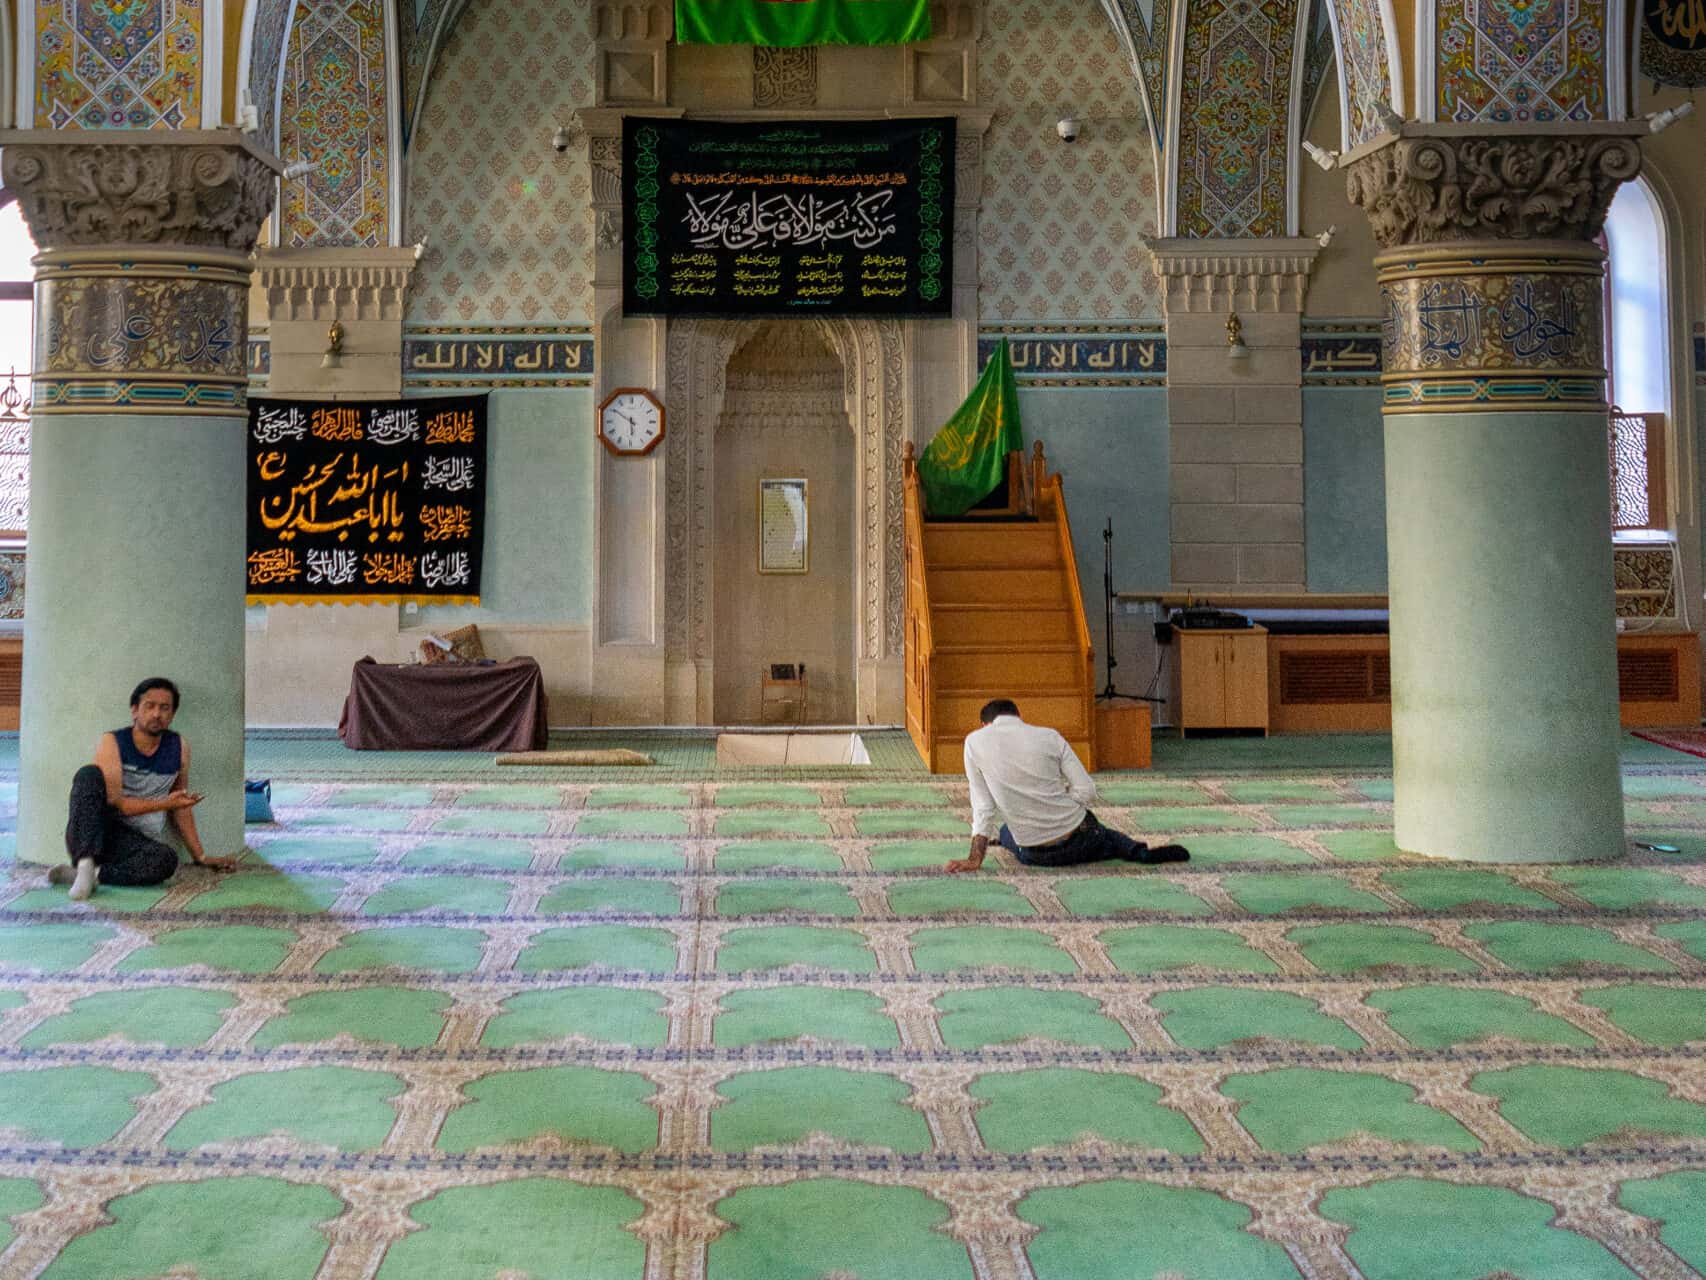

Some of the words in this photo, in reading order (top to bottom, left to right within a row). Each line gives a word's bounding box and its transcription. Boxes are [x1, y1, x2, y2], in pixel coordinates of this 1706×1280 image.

[685, 190, 733, 243] مولاه
[783, 193, 836, 246] مولاه
[825, 190, 893, 239] كنت
[853, 216, 896, 249] من
[412, 343, 468, 369] الله
[476, 343, 505, 369] الا
[513, 343, 555, 369] اله
[564, 343, 581, 369] لا
[1050, 343, 1079, 368] الا
[1087, 343, 1128, 368] اله
[1138, 343, 1155, 368] لا
